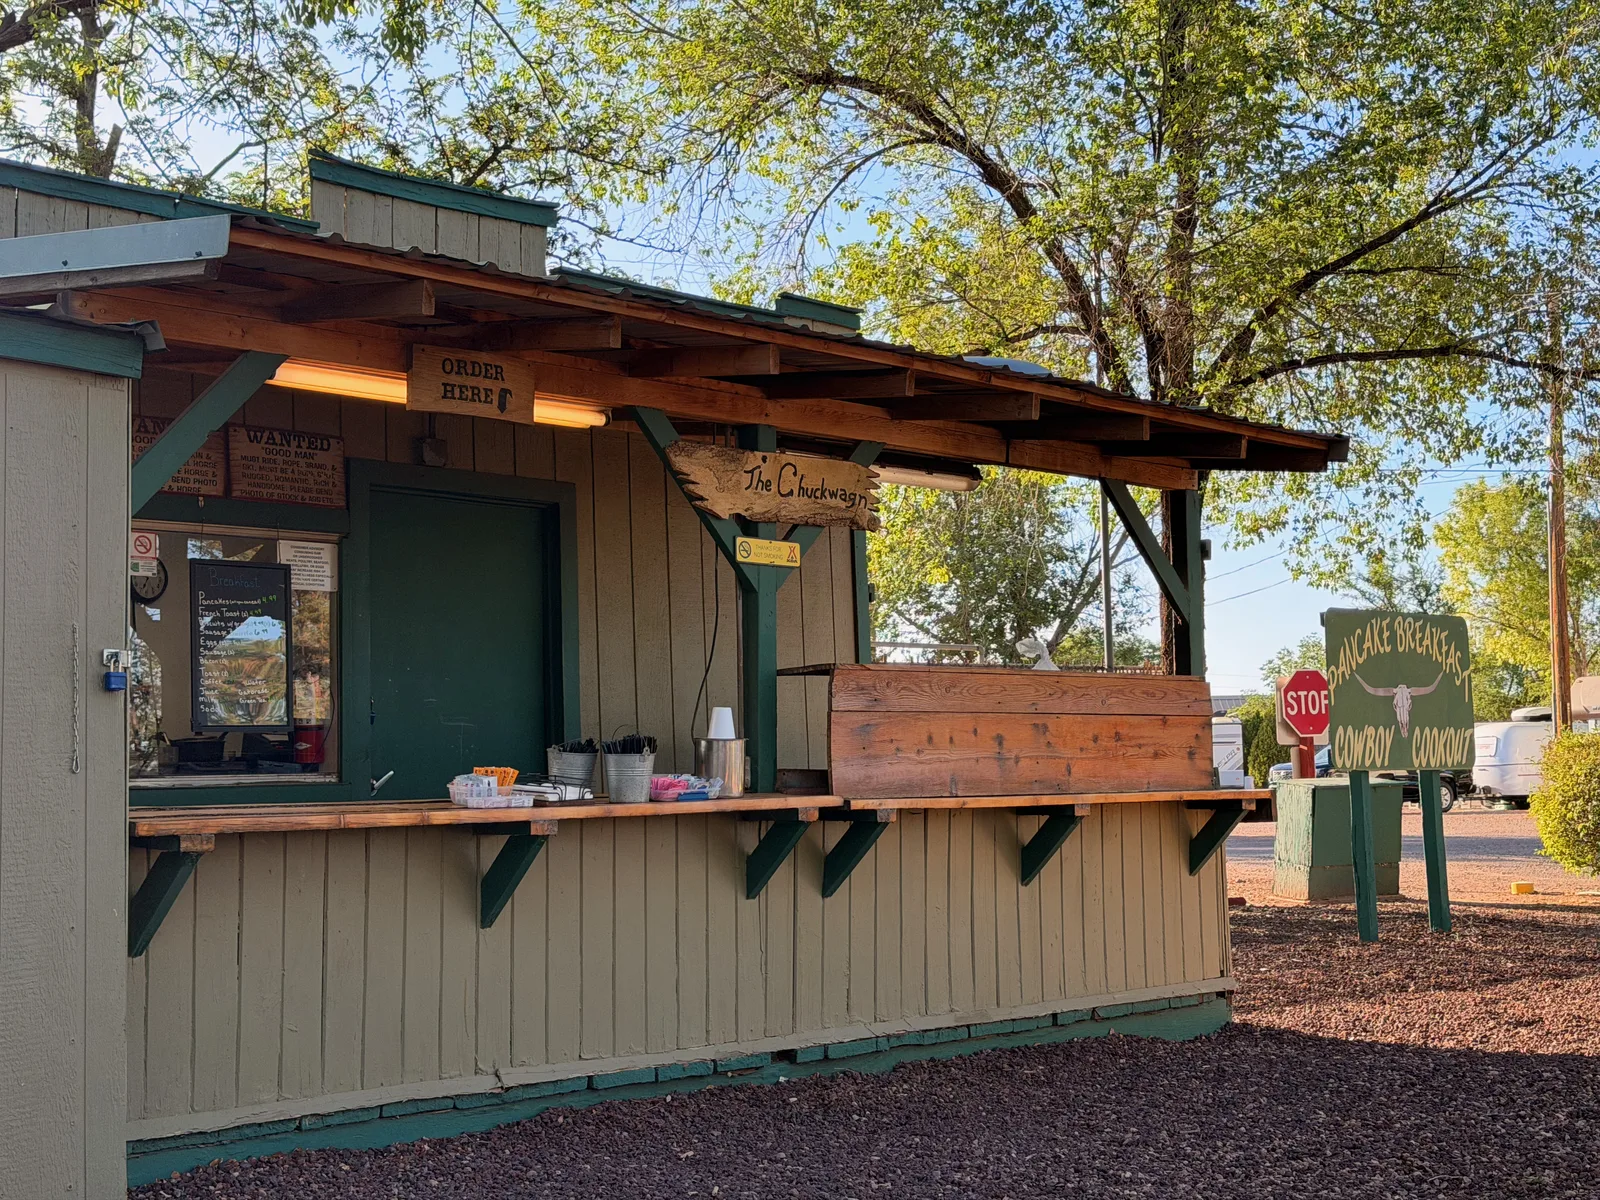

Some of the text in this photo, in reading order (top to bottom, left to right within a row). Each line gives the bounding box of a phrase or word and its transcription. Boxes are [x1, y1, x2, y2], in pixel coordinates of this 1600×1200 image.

[441, 357, 505, 381] ORDER
[441, 382, 493, 405] HERE
[245, 428, 331, 451] WANTED
[193, 460, 217, 469] HORSE
[240, 455, 260, 463] MUST
[184, 468, 208, 477] HORSE
[258, 465, 278, 473] MUST
[279, 467, 289, 475] BE
[171, 476, 218, 487] SEND PHOTO
[313, 479, 330, 487] RICH
[743, 462, 867, 509] The Chuckwagn
[176, 485, 202, 493] HORSE
[289, 485, 314, 494] PLEASE
[315, 487, 333, 496] SEND
[240, 489, 264, 497] PHOTO
[277, 492, 299, 501] STOCK
[764, 552, 784, 560] SMOKING
[208, 567, 261, 588] Breakfast
[198, 590, 229, 605] Pancakes
[198, 606, 221, 617] French
[220, 607, 240, 618] Toast
[200, 626, 228, 636] Sausage
[200, 636, 218, 648] Eggs
[200, 647, 227, 657] Sausage
[199, 656, 218, 664] Bacon
[1328, 615, 1471, 706] PANCAKE BREAKFAST
[199, 667, 220, 677] Toast
[199, 687, 269, 696] Juice Gatorade
[1334, 724, 1473, 769] COWBOY COOKOUT
